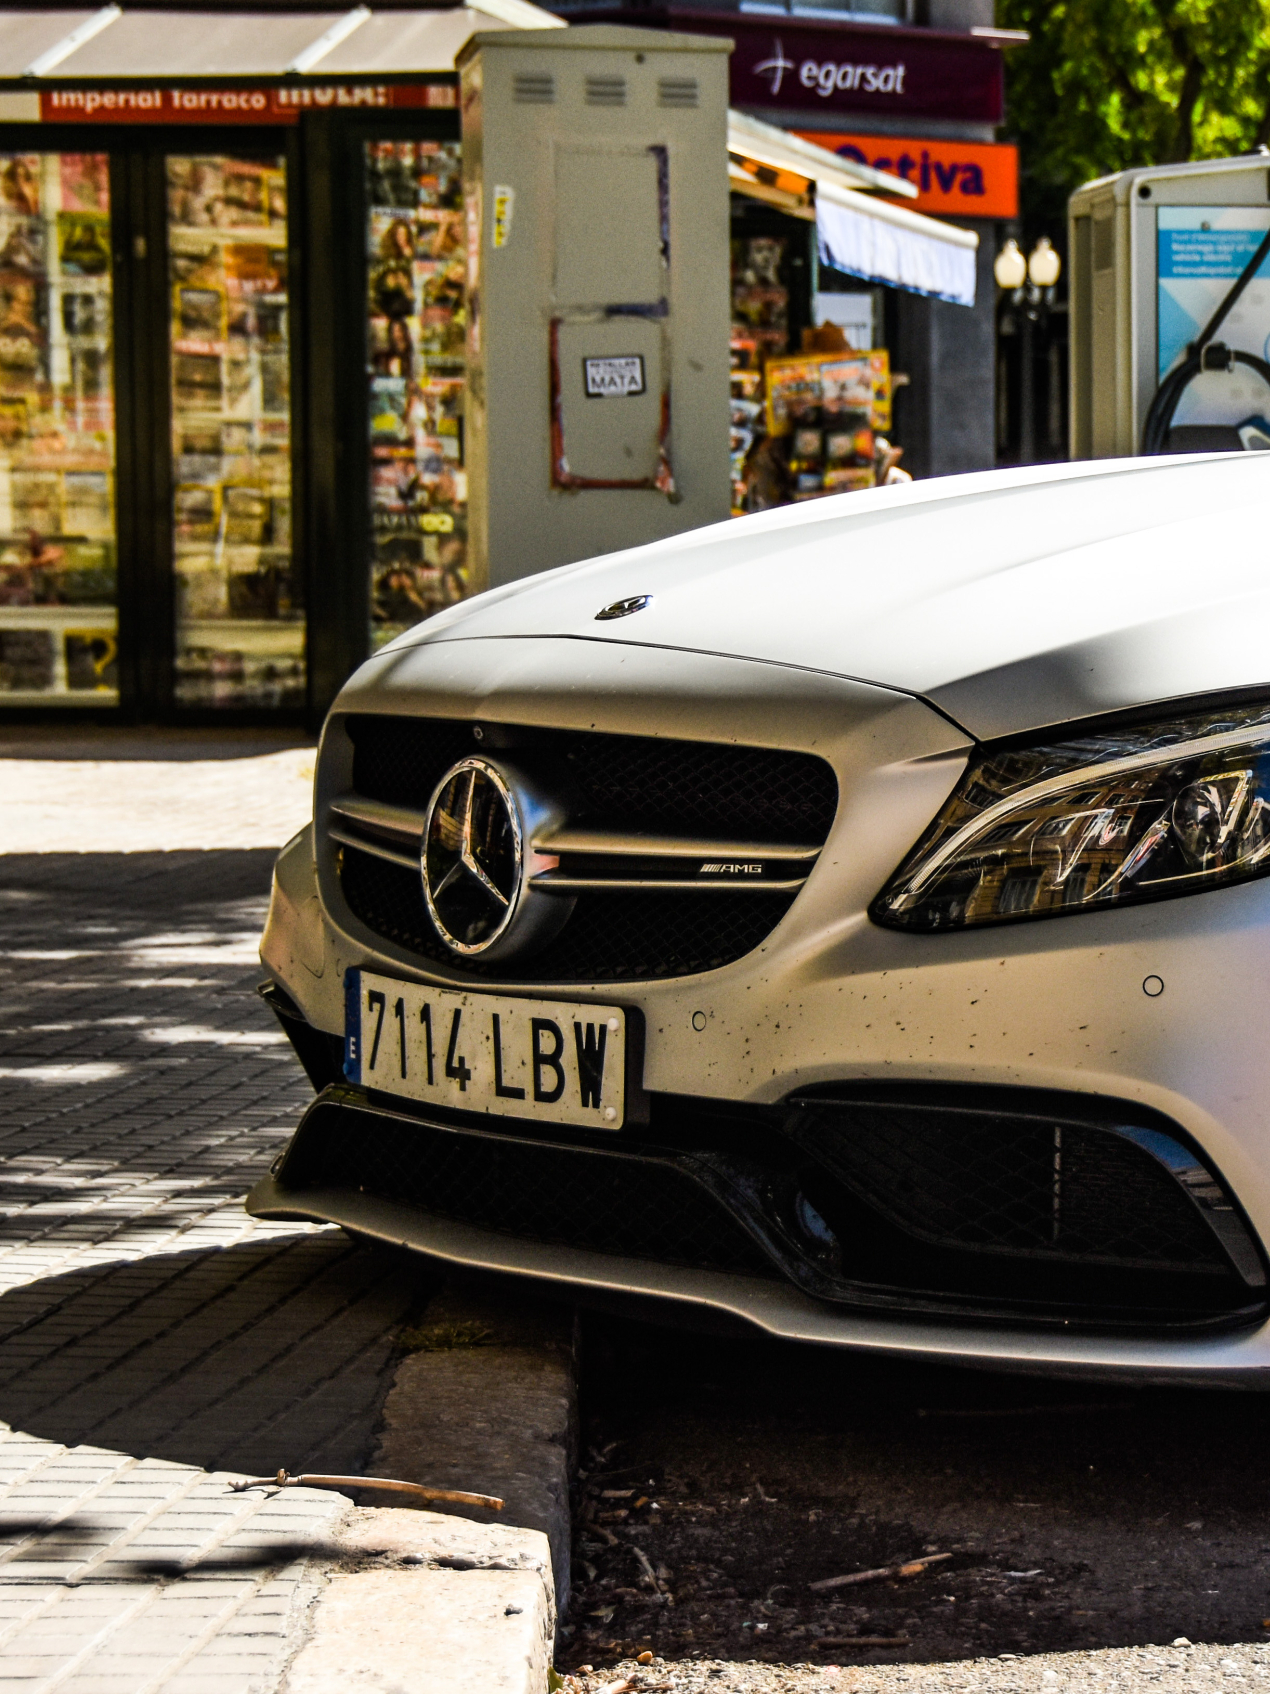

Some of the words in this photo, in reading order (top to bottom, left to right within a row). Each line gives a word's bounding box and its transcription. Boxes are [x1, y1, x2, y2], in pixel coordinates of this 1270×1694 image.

[800, 59, 906, 97] egarsat
[50, 88, 162, 114] Imperial
[171, 89, 268, 111] Tarraco
[590, 374, 639, 389] MATA
[720, 863, 762, 873] AMG
[349, 1036, 357, 1059] E
[367, 989, 472, 1092] 7114
[491, 1012, 608, 1110] LBW
